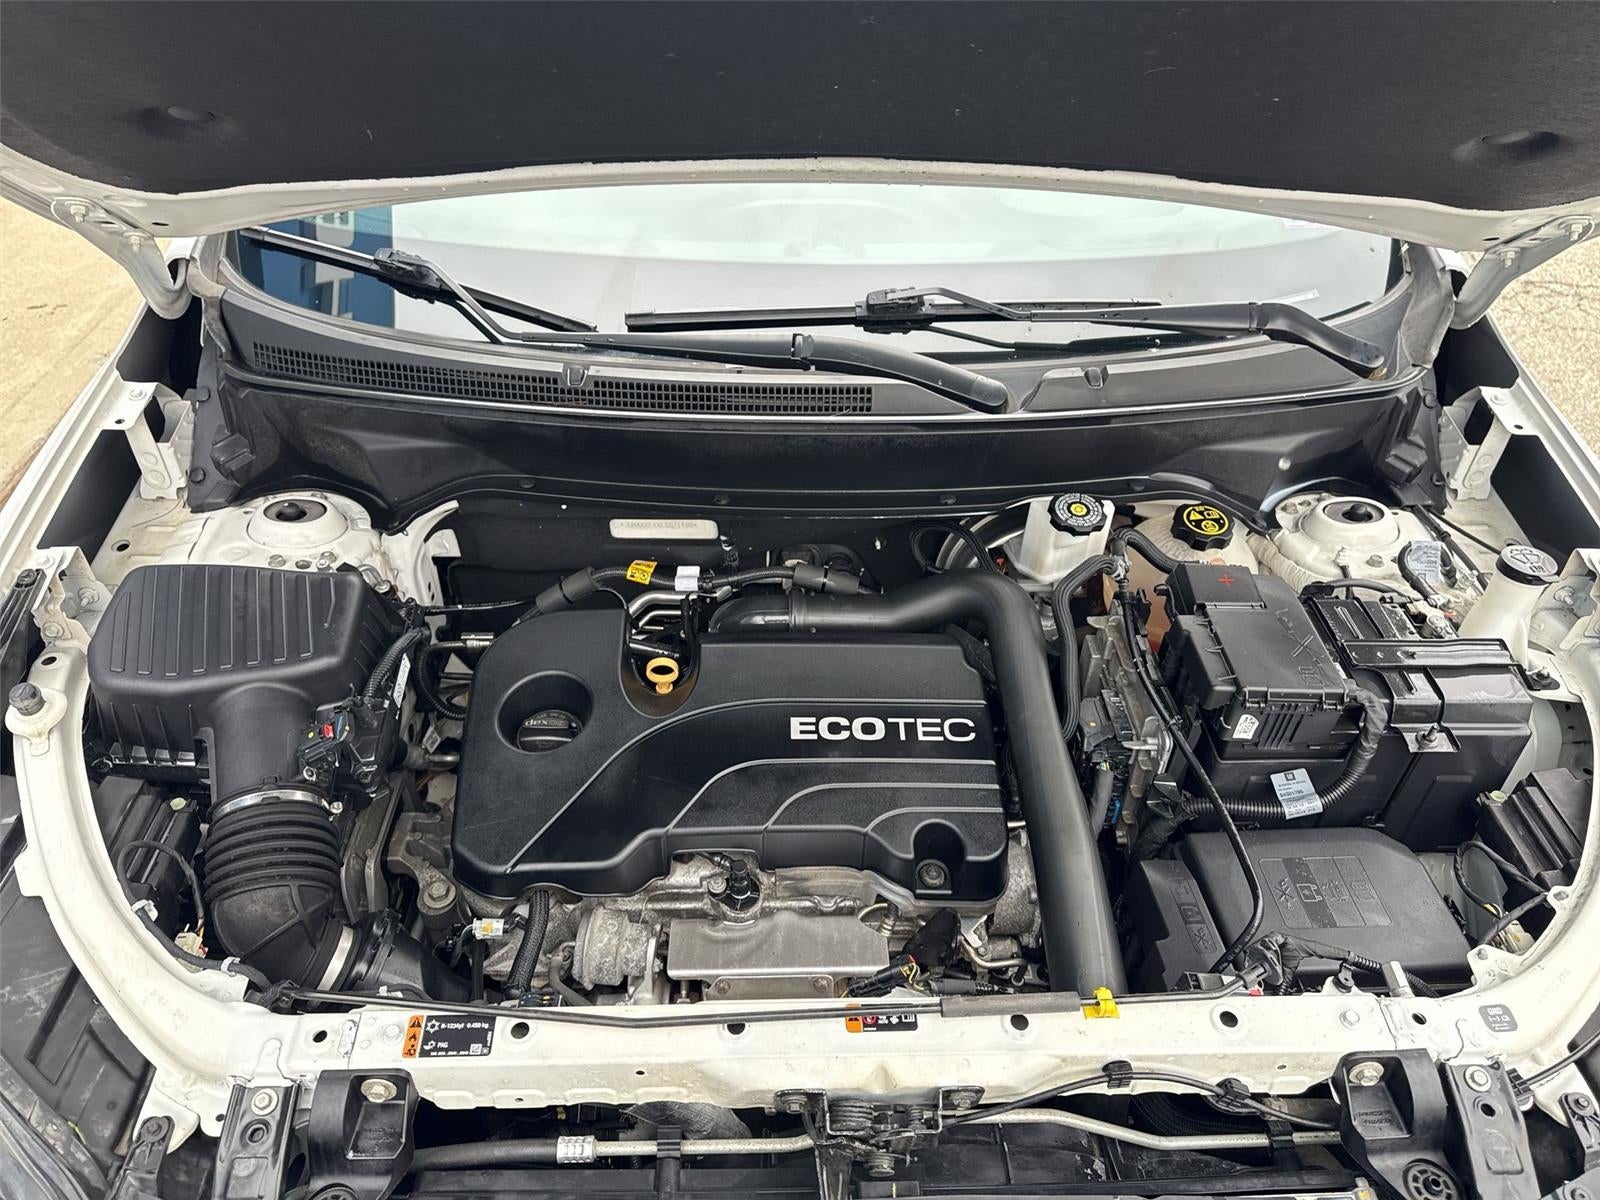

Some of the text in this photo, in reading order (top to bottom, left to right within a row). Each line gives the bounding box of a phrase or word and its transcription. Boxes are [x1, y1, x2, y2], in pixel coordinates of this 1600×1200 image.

[790, 716, 976, 742] ECOTEC
[481, 1021, 489, 1030] kg
[437, 1041, 449, 1049] PAG
